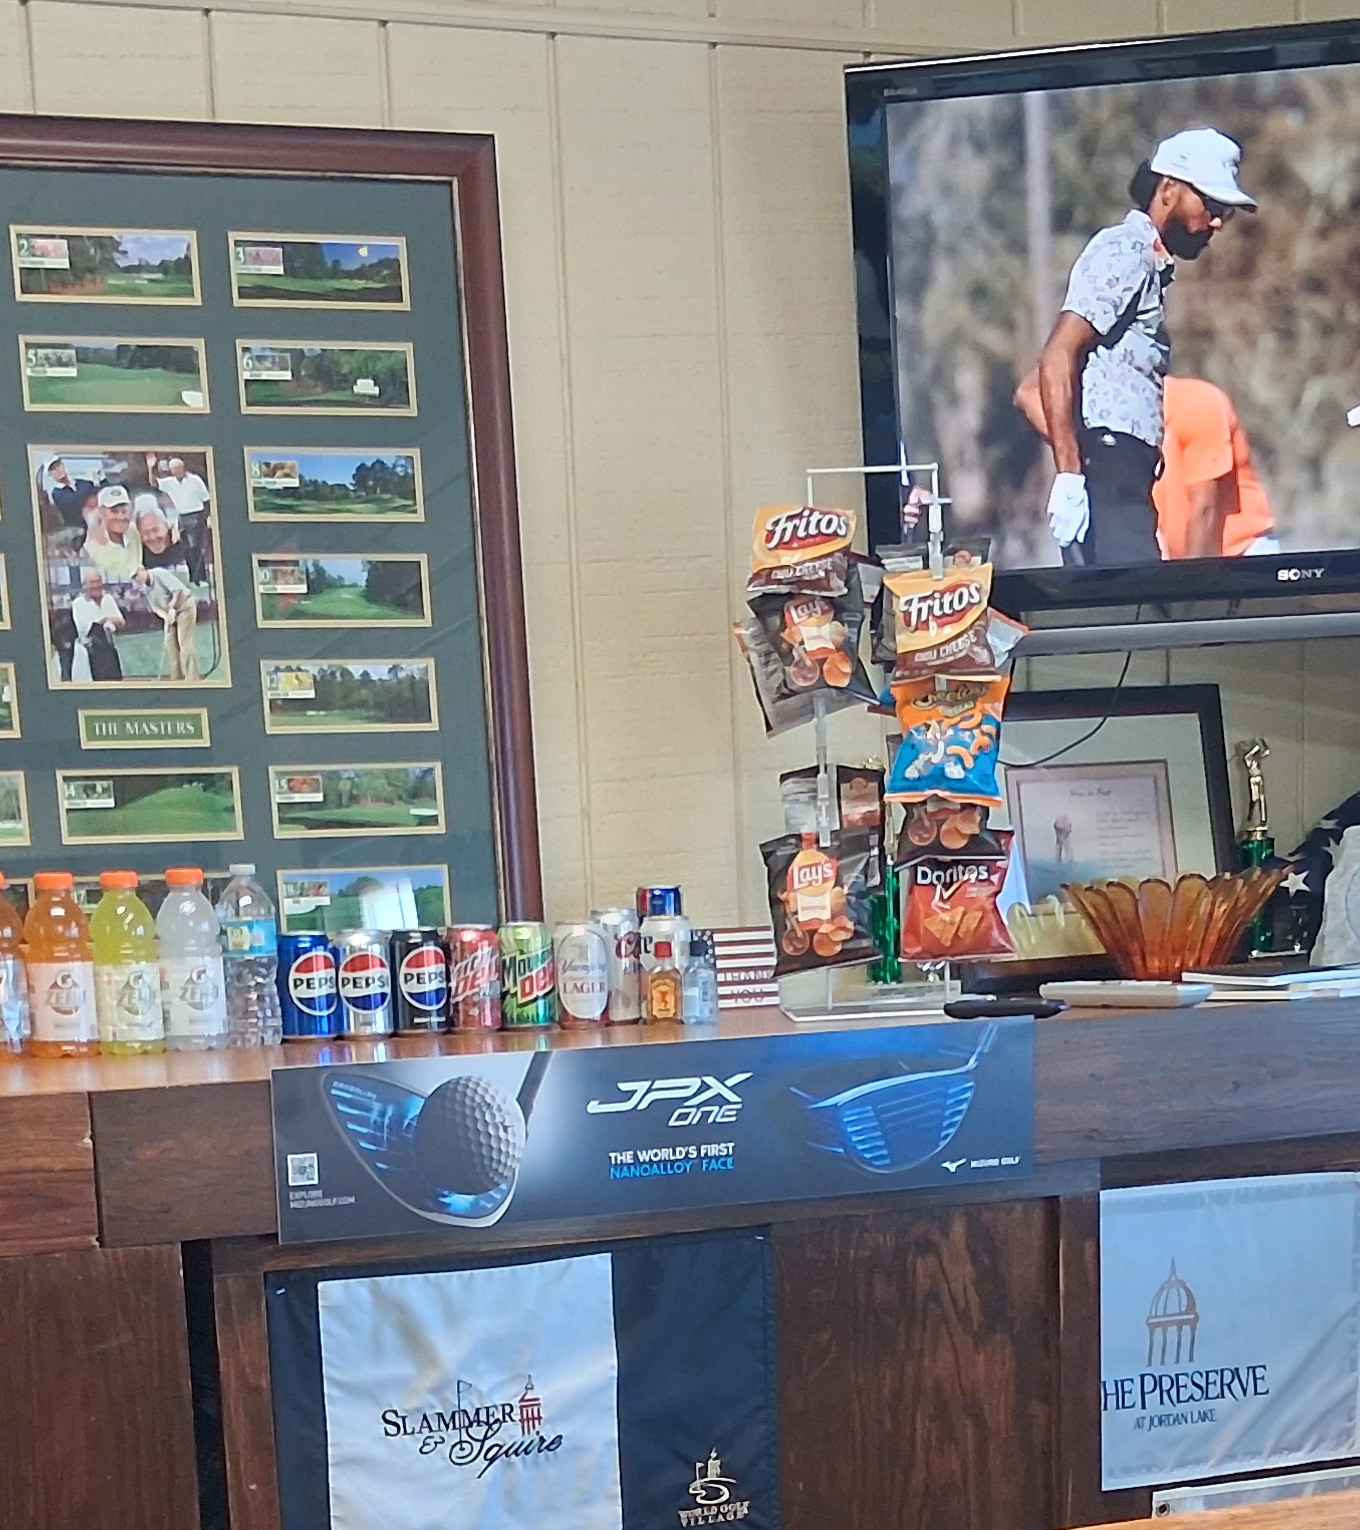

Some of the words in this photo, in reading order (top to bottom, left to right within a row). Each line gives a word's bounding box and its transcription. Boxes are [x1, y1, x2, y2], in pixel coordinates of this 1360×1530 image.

[763, 507, 850, 550] Fritos
[1276, 567, 1325, 582] SONY
[899, 579, 983, 633] Fritos
[94, 722, 118, 736] THE
[126, 720, 195, 736] MASTERS
[916, 862, 989, 886] Doritos
[292, 974, 336, 991] PEPS
[562, 981, 607, 994] LAGER
[587, 1071, 754, 1114] JPX
[668, 1103, 743, 1127] ONE
[609, 1151, 634, 1165] THE
[637, 1144, 698, 1163] WORLD'S
[701, 1142, 735, 1157] FIRST
[610, 1160, 692, 1179] NANOALLOY
[702, 1157, 735, 1171] FACE
[1102, 1377, 1137, 1412] HE
[1139, 1364, 1271, 1411] PRESERVE
[381, 1402, 517, 1438] SLAMMER
[1148, 1411, 1190, 1432] JORDAN
[1190, 1408, 1217, 1424] LAKE
[448, 1417, 564, 1480] Squire
[680, 1510, 746, 1528] VILLAGE
